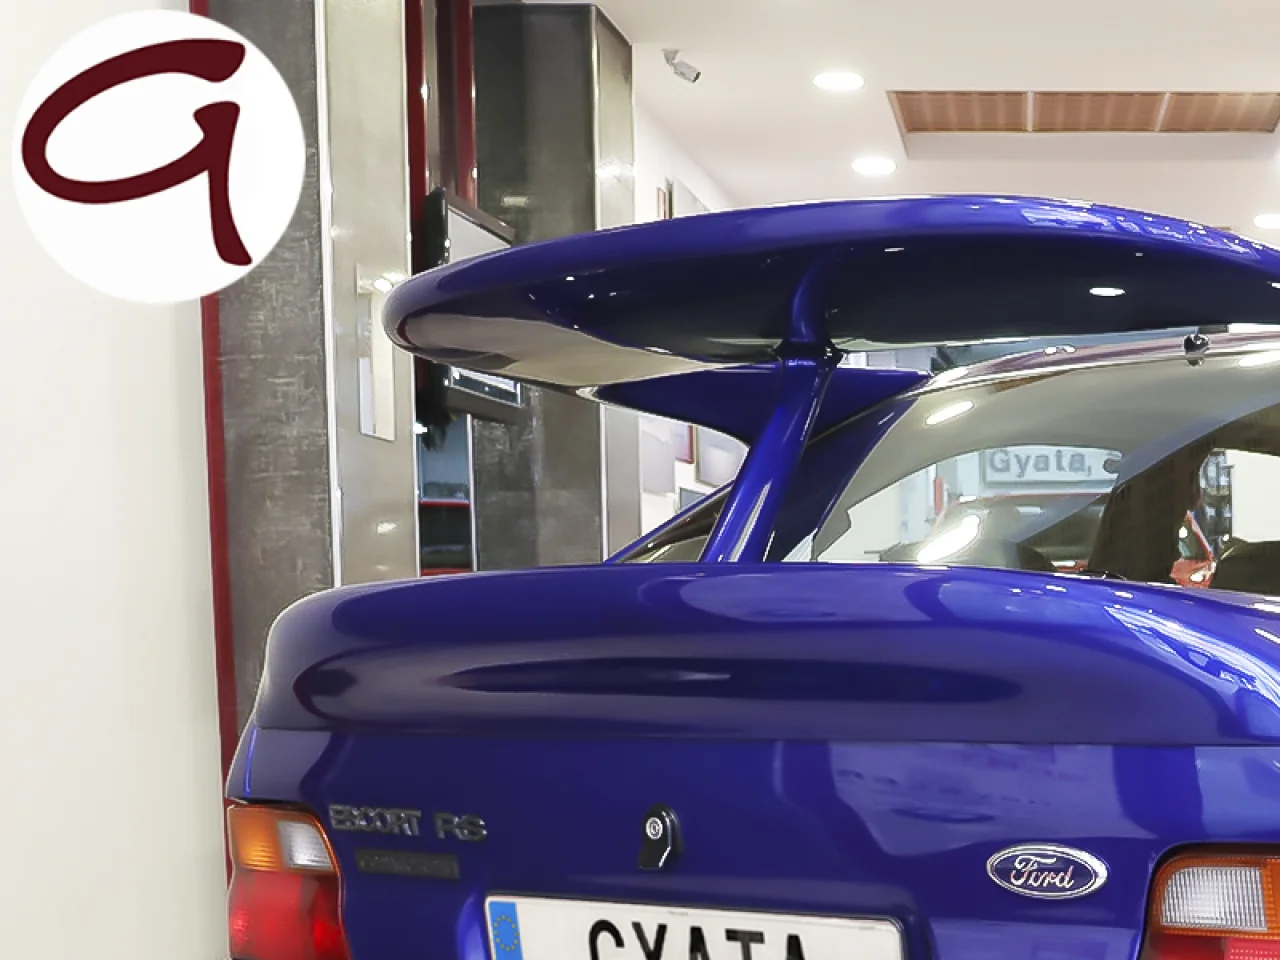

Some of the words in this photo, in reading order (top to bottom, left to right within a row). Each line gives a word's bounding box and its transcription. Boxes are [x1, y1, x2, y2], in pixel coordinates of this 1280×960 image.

[329, 804, 421, 836] ESCORT
[433, 811, 488, 841] RS
[1010, 855, 1074, 888] Ford
